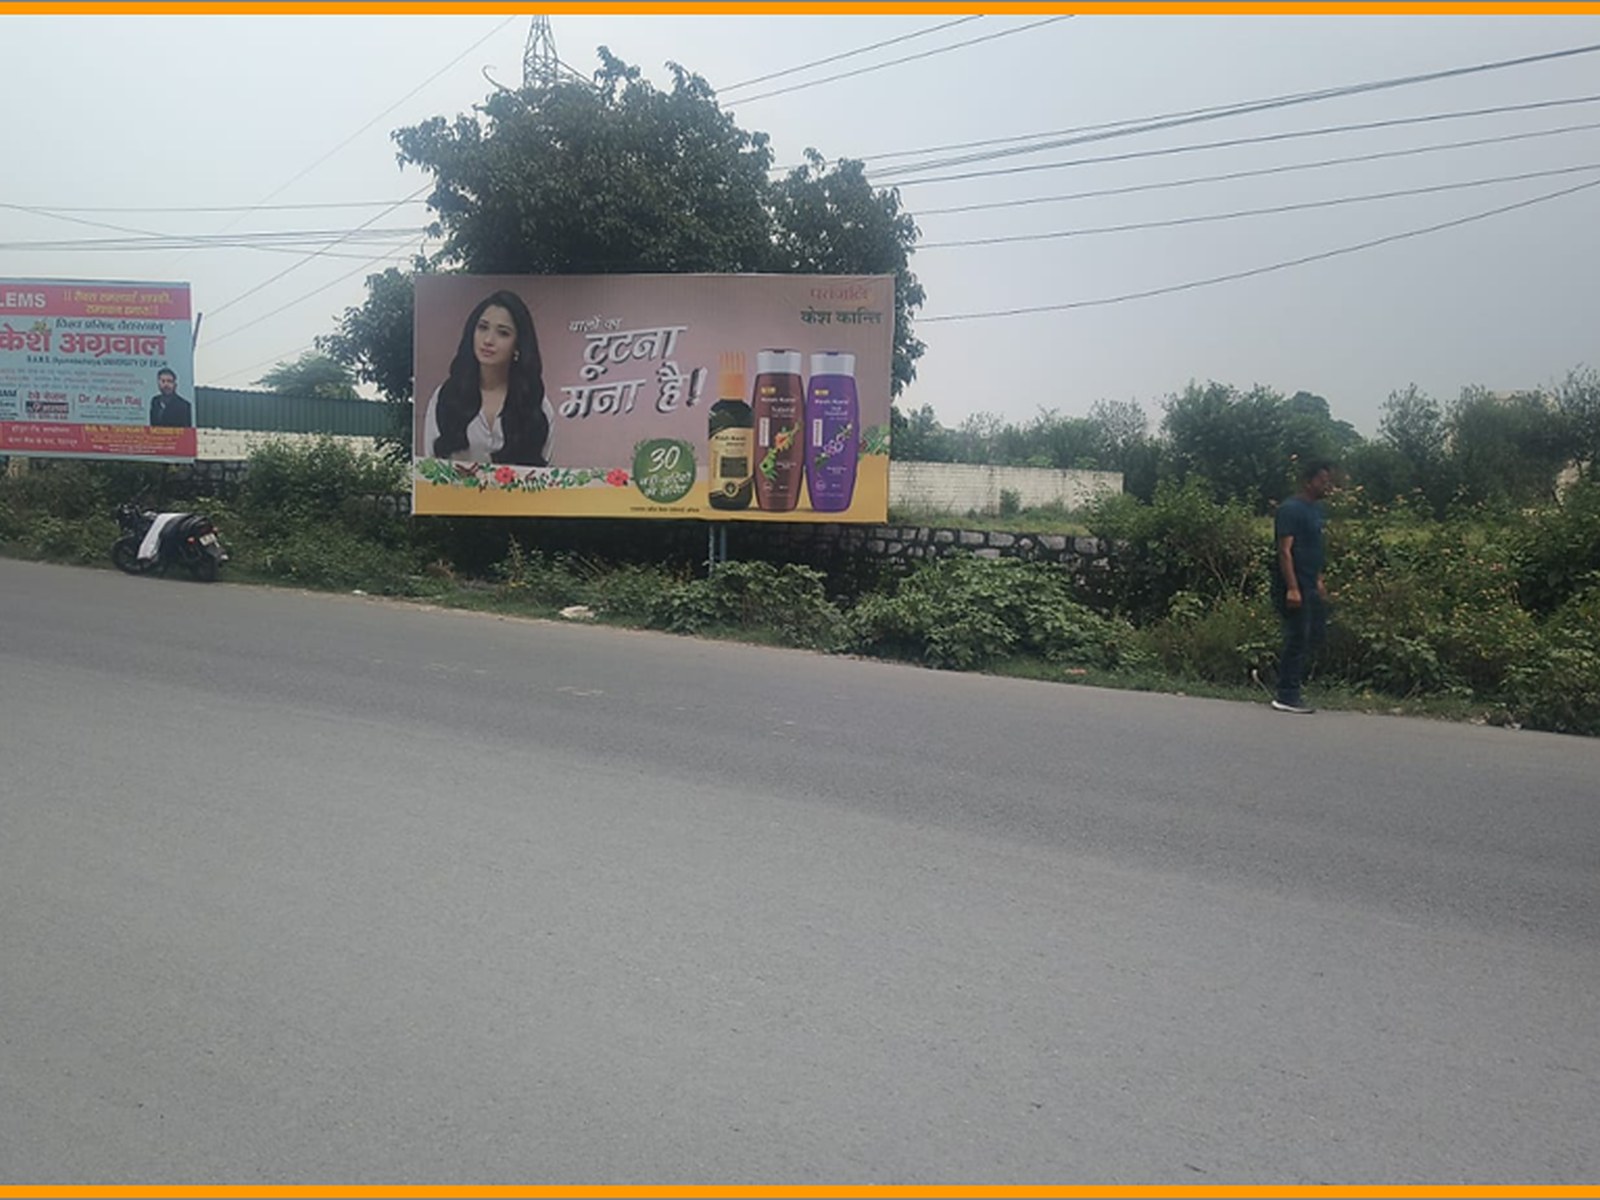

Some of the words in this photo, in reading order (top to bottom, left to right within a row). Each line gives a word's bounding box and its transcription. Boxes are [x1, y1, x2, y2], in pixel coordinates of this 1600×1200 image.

[0, 291, 46, 309] EMS
[800, 305, 832, 325] केश
[835, 305, 882, 325] कान्ति
[59, 333, 167, 358] अग्रवाल
[580, 326, 688, 381] टूटना
[560, 379, 648, 418] मना
[648, 445, 681, 473] 30
